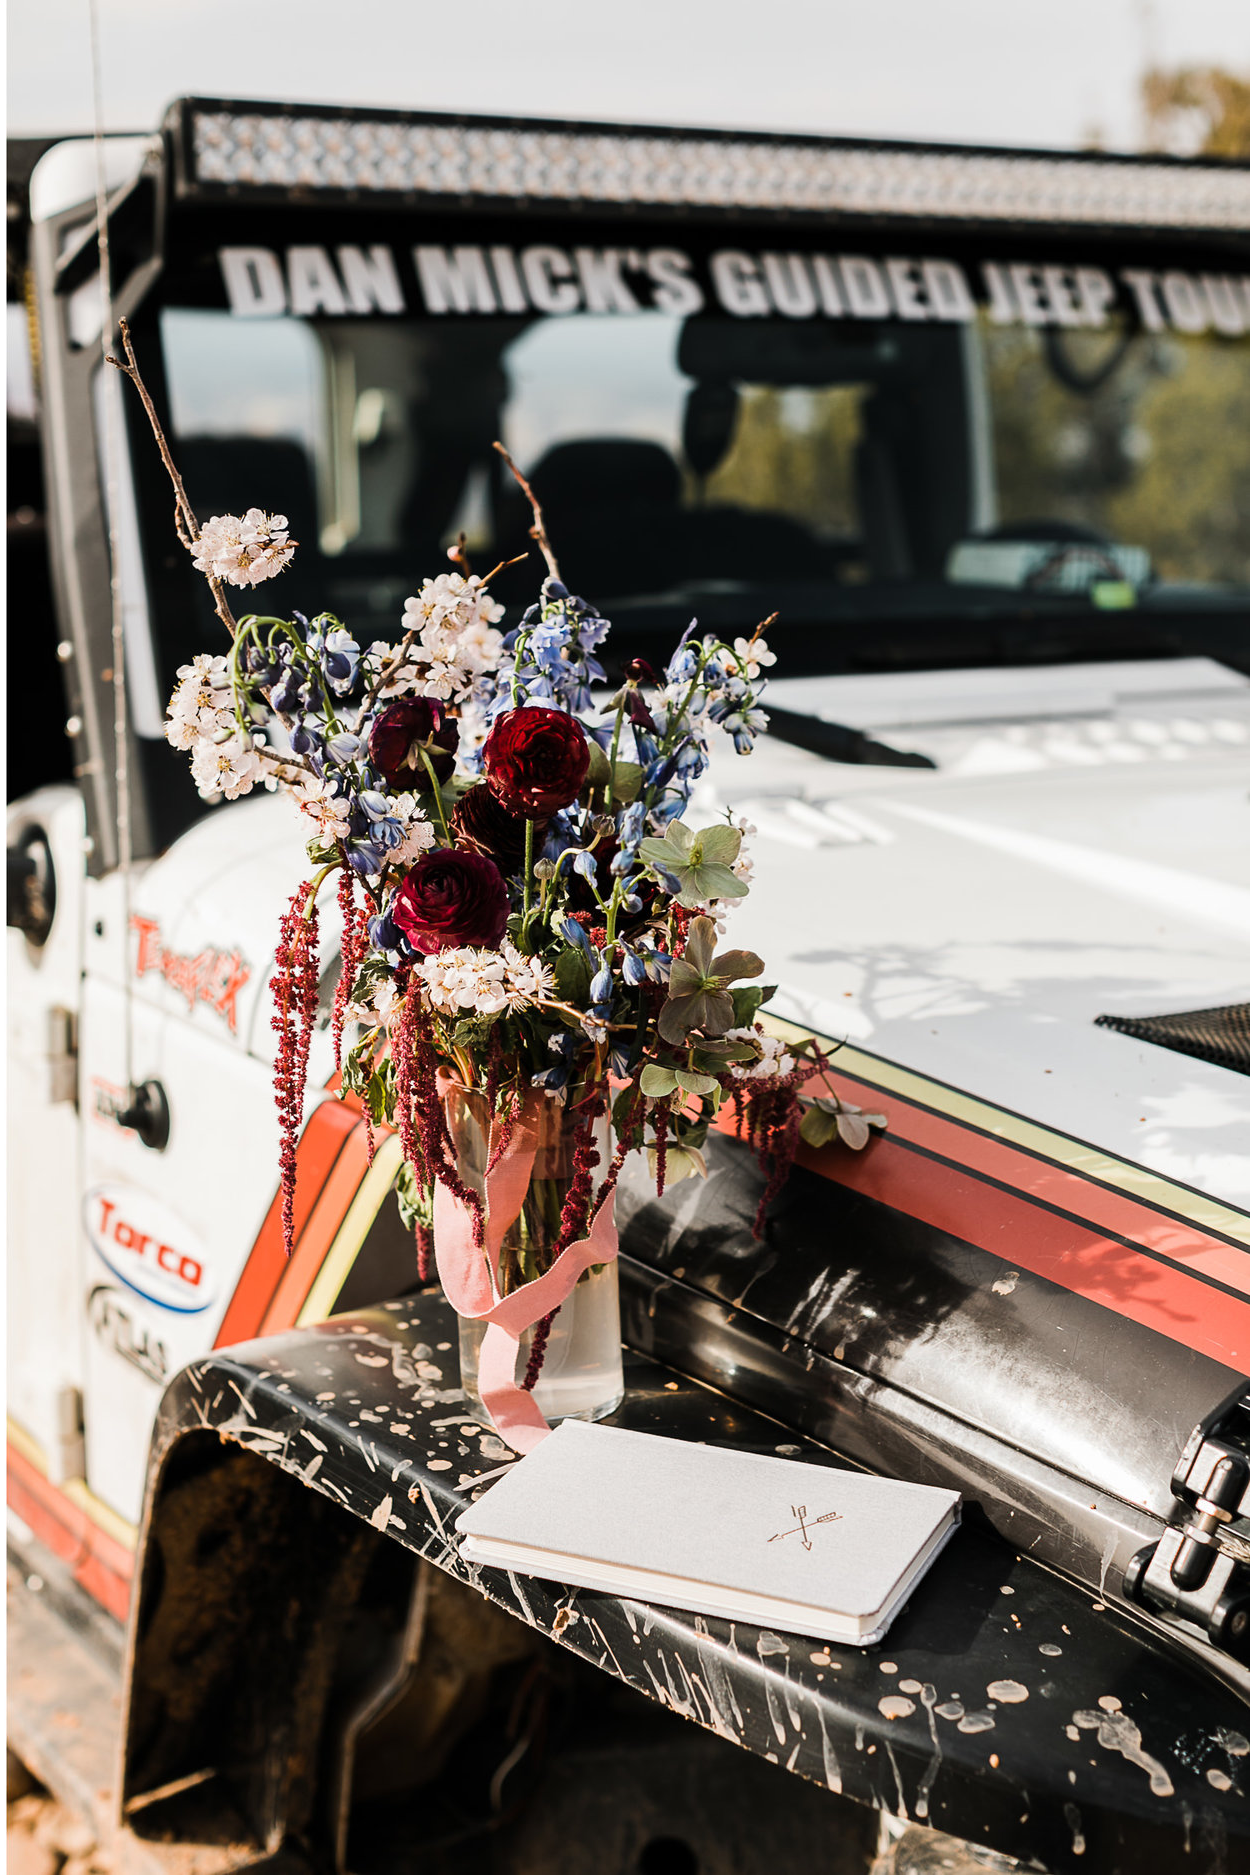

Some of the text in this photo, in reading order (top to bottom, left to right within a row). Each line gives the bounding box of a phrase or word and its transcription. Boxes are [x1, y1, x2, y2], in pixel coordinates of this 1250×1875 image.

[219, 246, 405, 318] DAN
[413, 246, 704, 317] MICK'S
[710, 251, 977, 320] GUIDED
[980, 261, 1114, 326] JEEP
[95, 1195, 203, 1286] Torco
